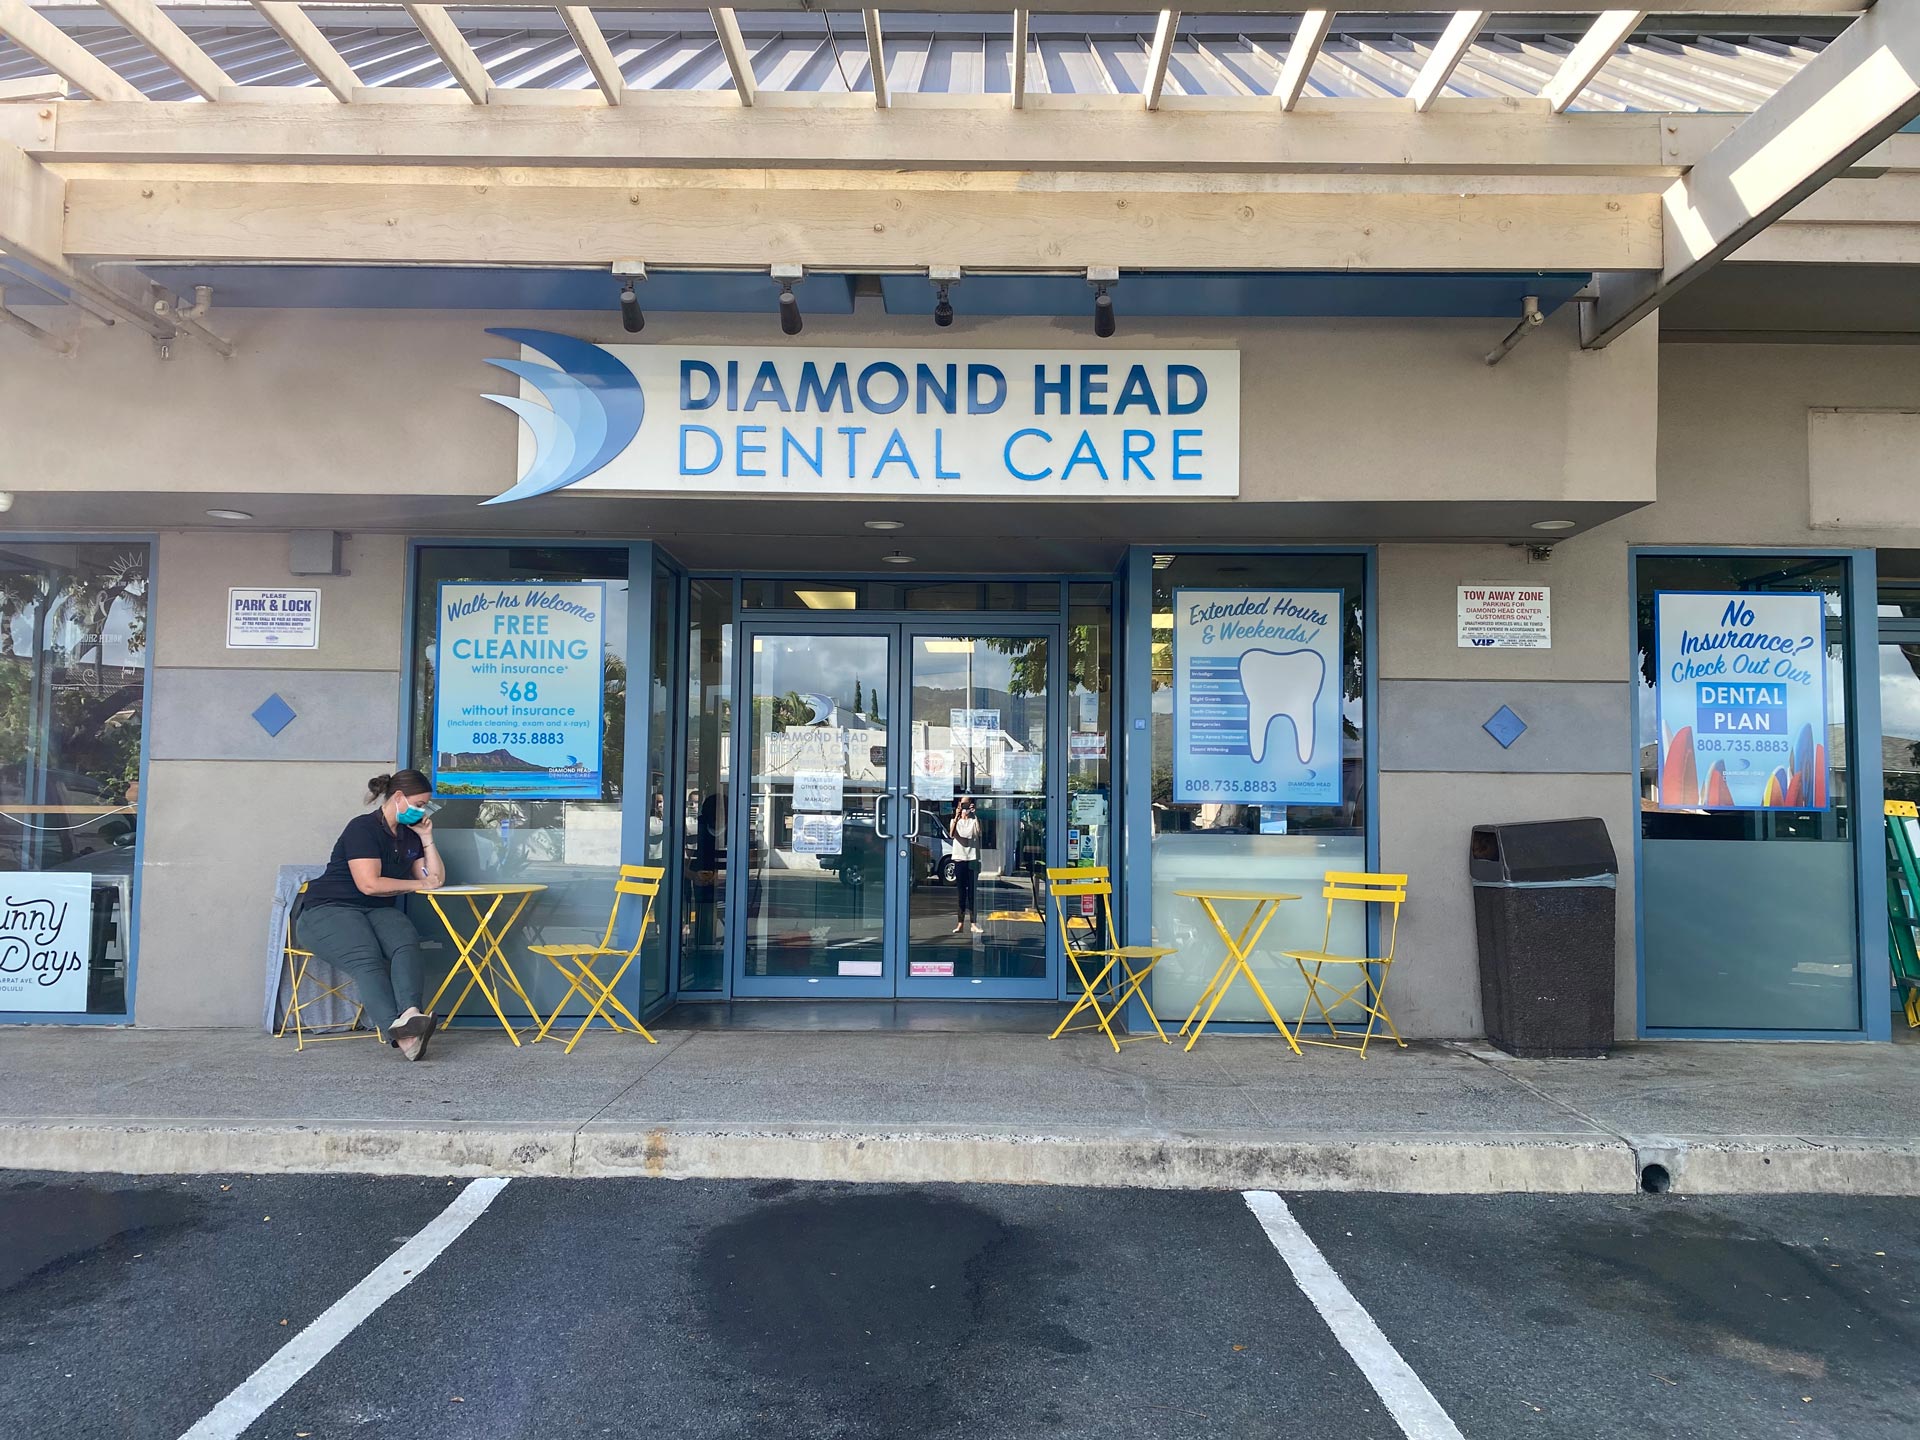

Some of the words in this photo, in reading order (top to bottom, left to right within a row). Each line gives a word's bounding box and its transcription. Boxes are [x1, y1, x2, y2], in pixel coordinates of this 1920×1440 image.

[680, 360, 1007, 415] DIAMOND
[1034, 364, 1208, 415] HEAD
[680, 424, 960, 480] DENTAL
[1004, 428, 1203, 481] CARE
[1464, 590, 1485, 600] TOW
[1488, 591, 1515, 600] AWAY
[1518, 592, 1544, 601] ZONE
[235, 600, 266, 611] PARK
[270, 600, 278, 611] &
[282, 600, 312, 612] LOCK
[447, 590, 520, 621] Walk-Ins
[525, 590, 596, 622] Welcome
[1189, 596, 1269, 626] Extended
[1273, 598, 1328, 626] Hours
[1721, 600, 1755, 627] No
[494, 614, 548, 635] FREE
[1202, 624, 1216, 644] &
[1220, 619, 1320, 644] Weekends!
[452, 639, 588, 660] CLEANING
[1681, 630, 1814, 656] Insurance?
[472, 663, 496, 673] with
[1671, 654, 1727, 683] Check
[1733, 654, 1770, 675] Out
[1774, 659, 1812, 686] Our
[500, 681, 538, 701] $68
[1701, 687, 1783, 705] DENTAL
[462, 704, 508, 716] without
[512, 705, 575, 716] insurance
[1714, 712, 1770, 731] PLAN
[472, 732, 564, 744] 808.735.8883
[770, 732, 831, 742] DIAMOND
[836, 733, 868, 742] HEAD
[1697, 739, 1789, 752] 808.735.8883
[770, 744, 824, 754] DENTAL
[830, 744, 868, 754] CARE
[1185, 780, 1277, 792] 808.735.8883
[0, 936, 81, 986] Days
